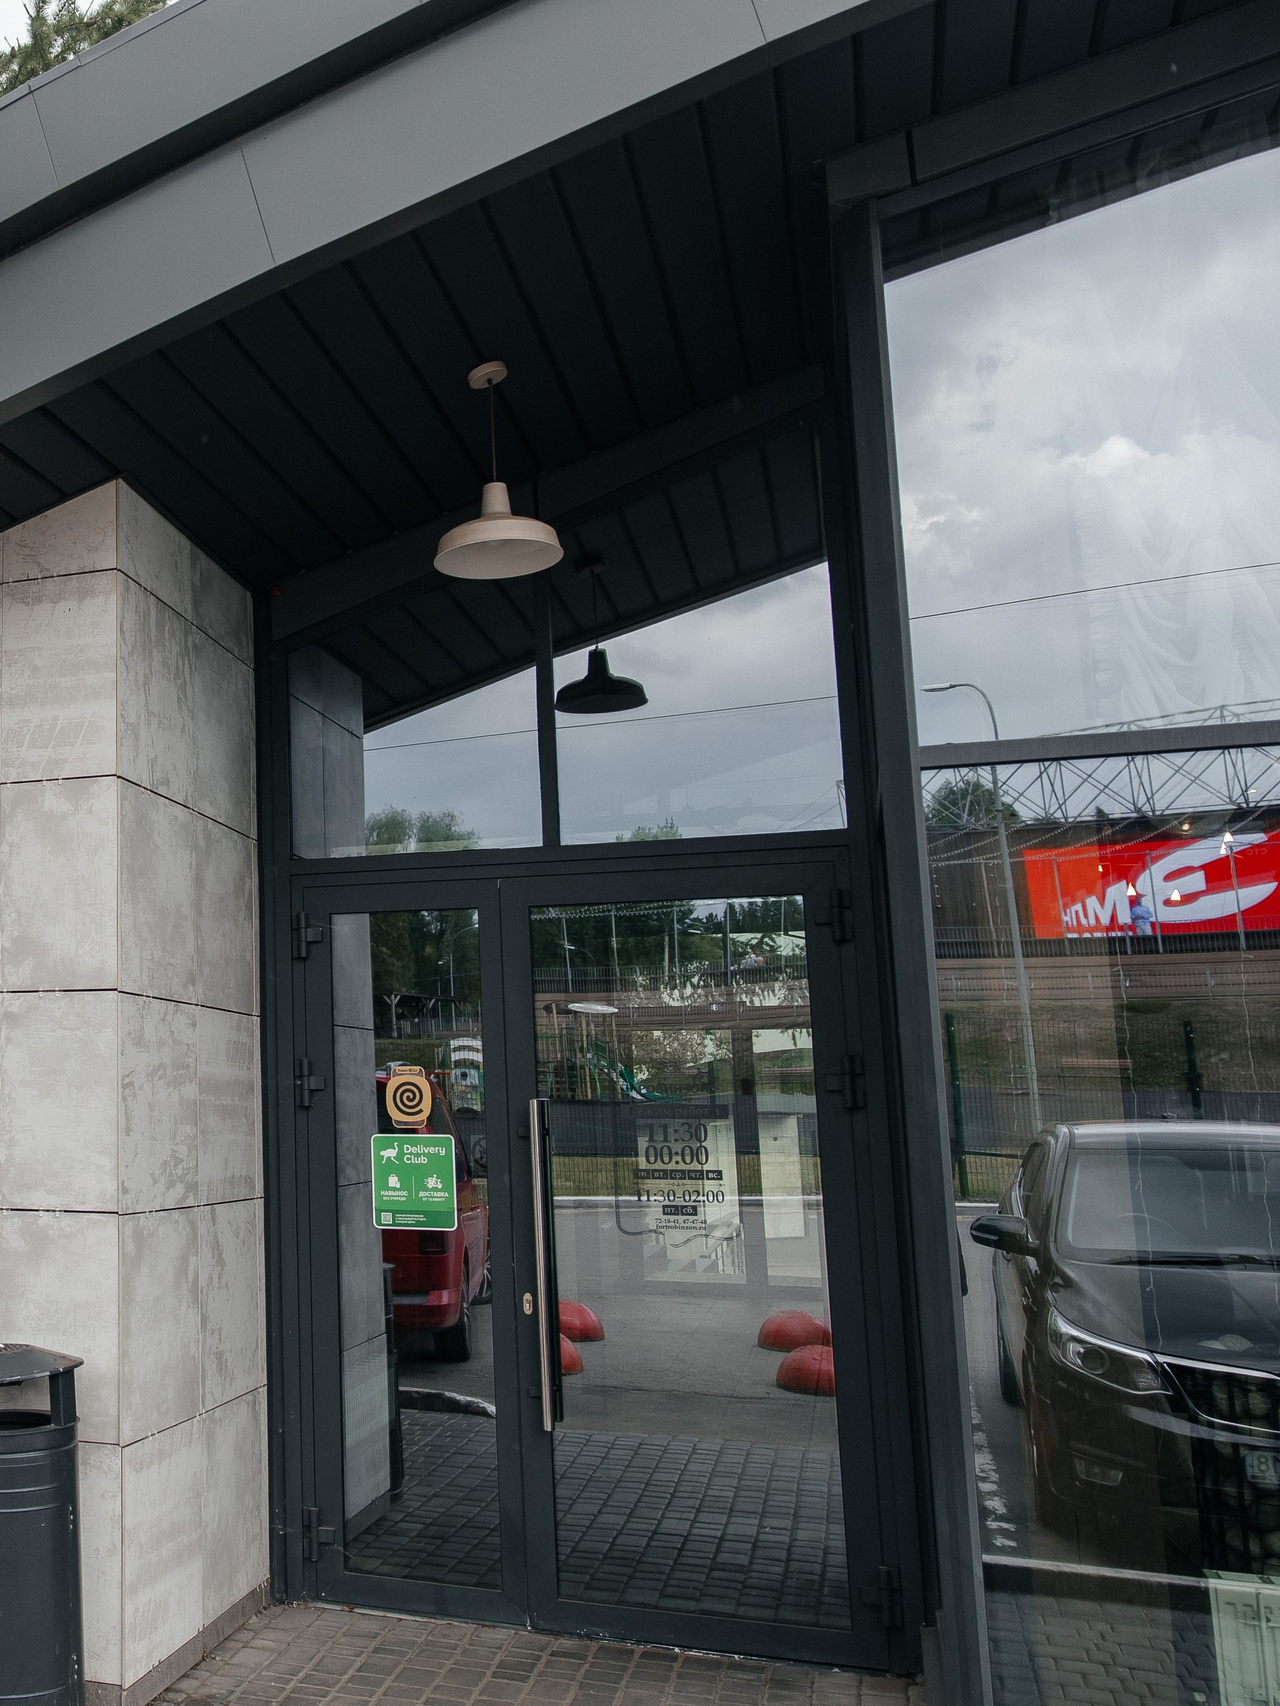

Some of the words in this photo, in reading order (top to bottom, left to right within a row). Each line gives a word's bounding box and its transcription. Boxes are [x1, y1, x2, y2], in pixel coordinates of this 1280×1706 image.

[645, 1122, 708, 1143] 11:30
[404, 1145, 445, 1156] Delivery
[644, 1144, 709, 1165] 00:00
[404, 1155, 428, 1164] Club
[636, 1189, 725, 1203] 11:30-02:00
[682, 1206, 695, 1214] сб.
[655, 1223, 707, 1231] fortrobinzon.ru
